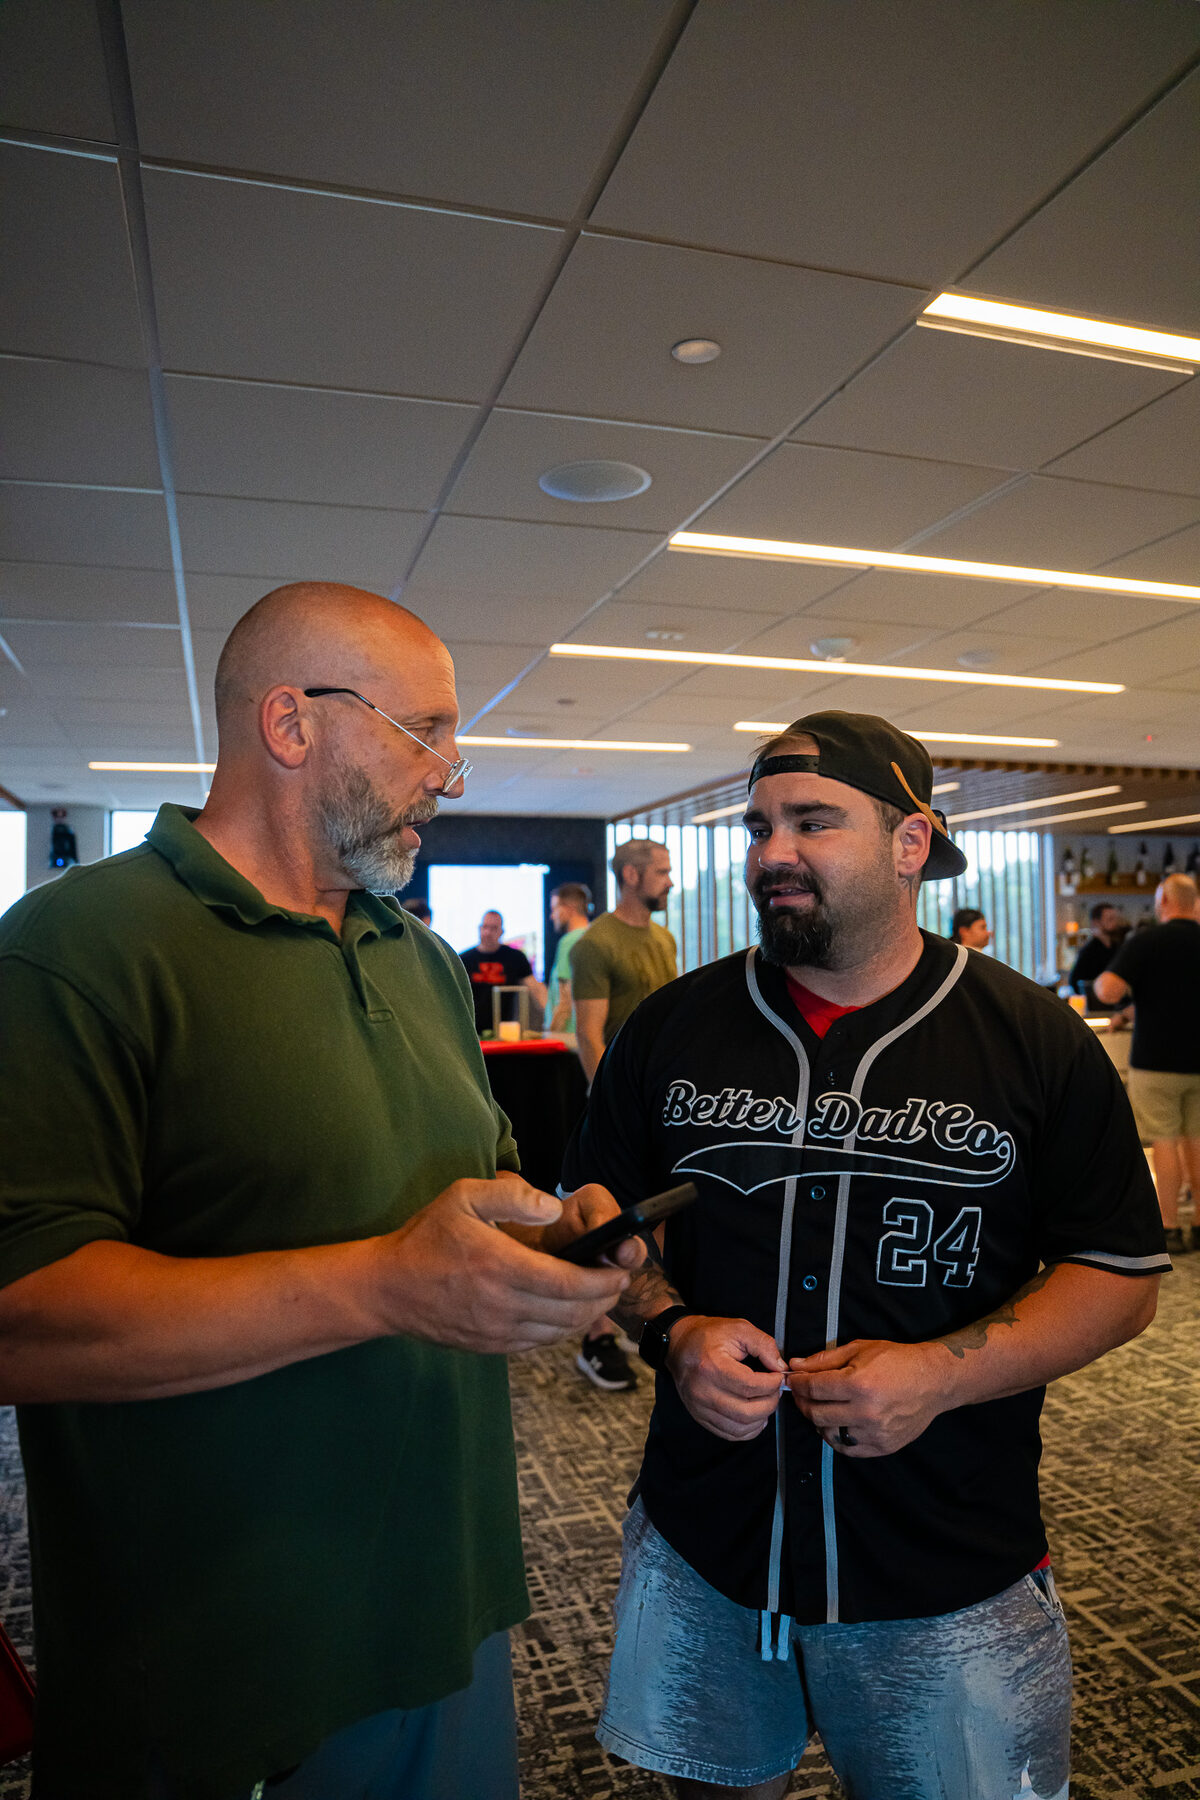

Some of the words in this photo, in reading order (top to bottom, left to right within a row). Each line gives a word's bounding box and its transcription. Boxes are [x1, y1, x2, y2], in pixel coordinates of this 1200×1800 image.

[663, 1079, 805, 1134] Better
[808, 1091, 927, 1144] Dad
[876, 1197, 982, 1288] 24
